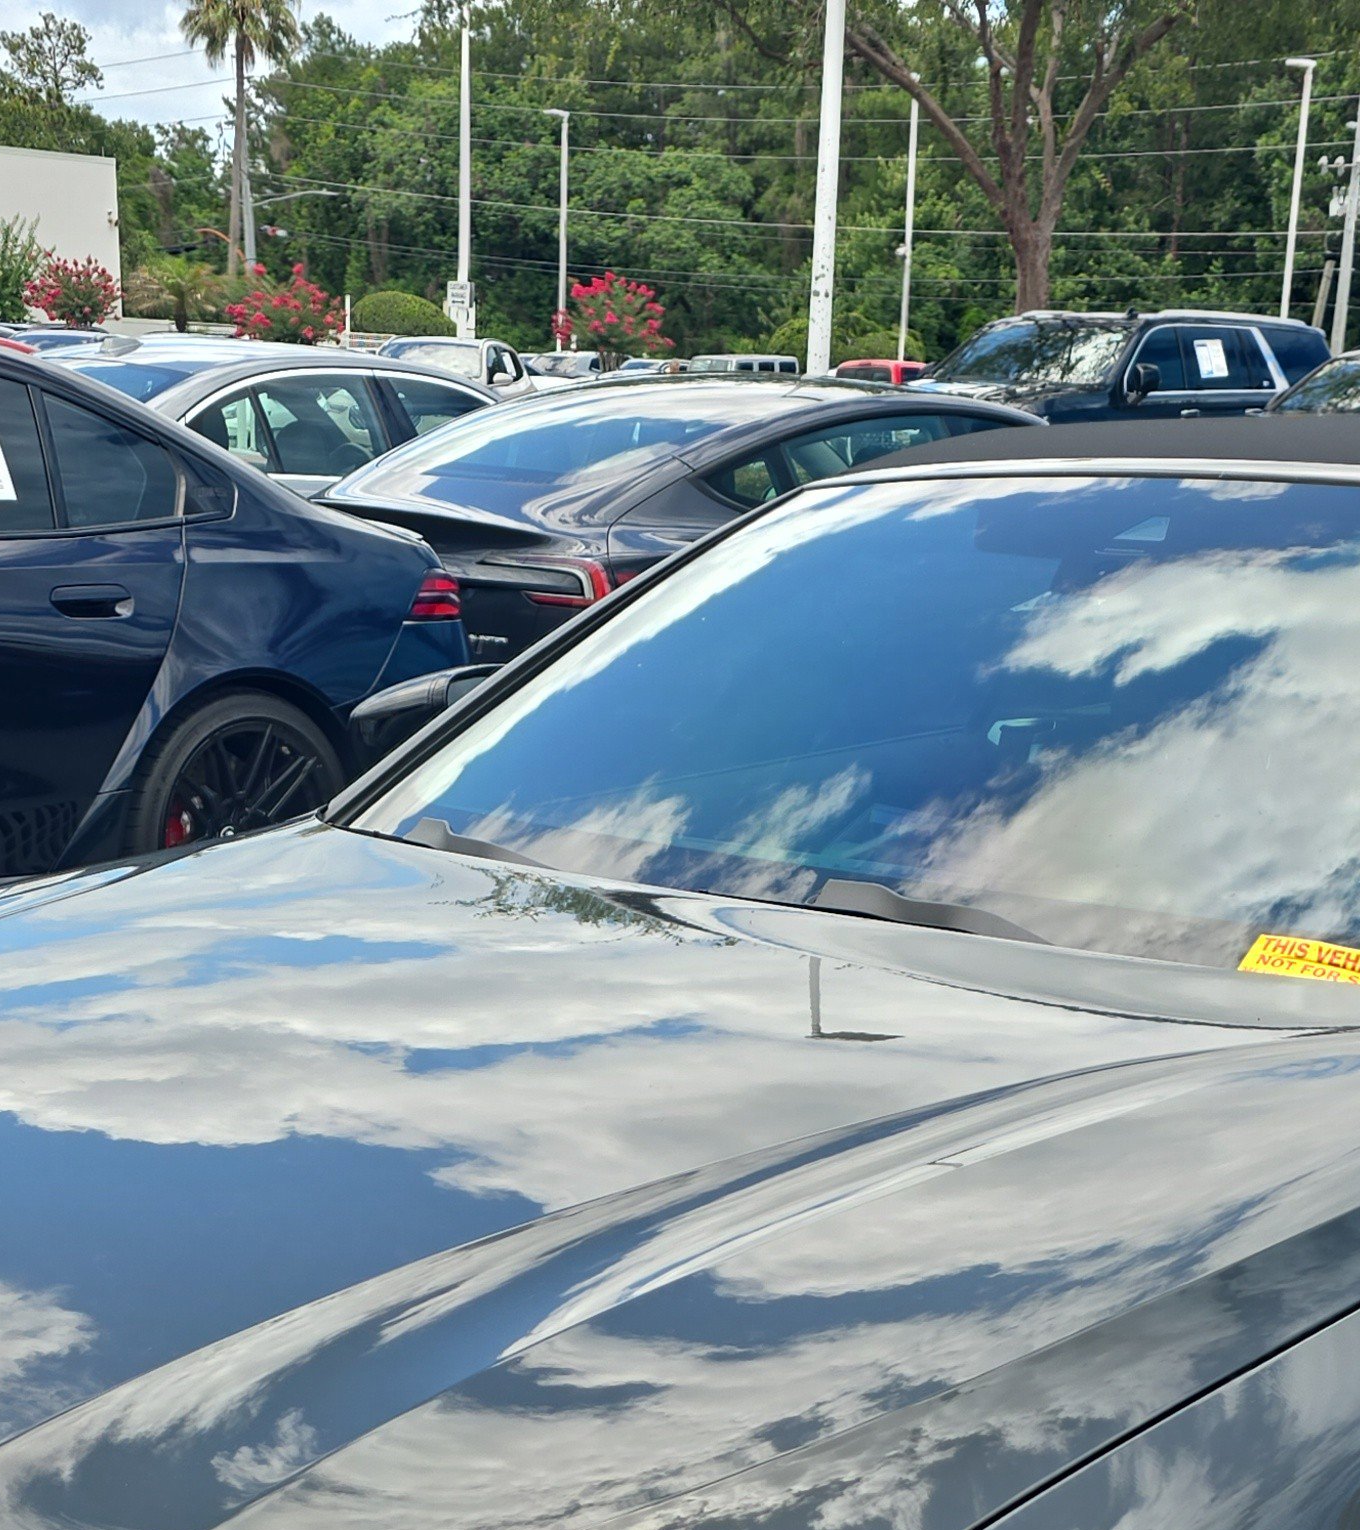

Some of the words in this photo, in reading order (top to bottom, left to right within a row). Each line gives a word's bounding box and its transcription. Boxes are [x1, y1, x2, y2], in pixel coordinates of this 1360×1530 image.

[1263, 937, 1310, 959] THIS
[1256, 954, 1297, 970] NOT
[1300, 964, 1341, 982] FOR
